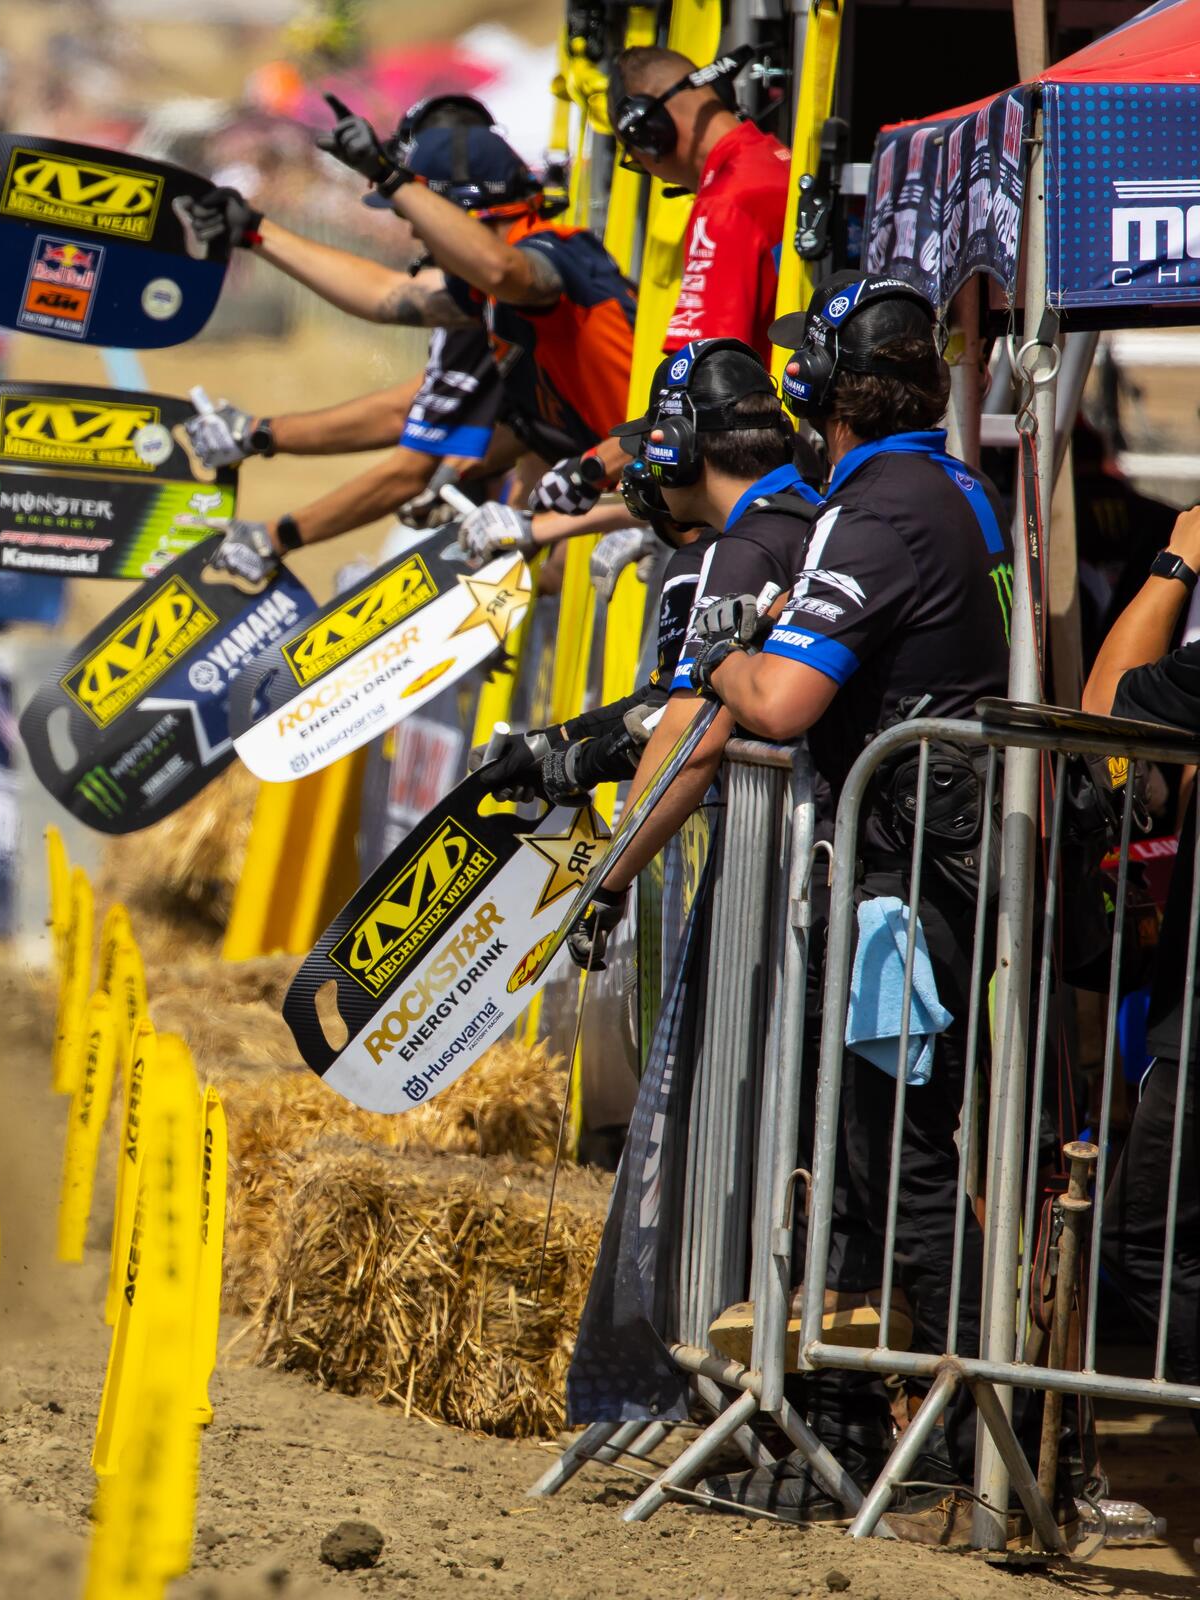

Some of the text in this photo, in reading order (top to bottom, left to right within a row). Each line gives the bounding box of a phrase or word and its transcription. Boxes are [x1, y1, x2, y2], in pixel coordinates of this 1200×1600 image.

[97, 213, 147, 234] WEAR
[34, 291, 81, 313] KTM
[0, 489, 115, 521] MONSTER
[14, 514, 97, 530] ENERGY
[1, 547, 99, 573] Kawasaki
[208, 589, 298, 670] YAMAHA
[768, 628, 816, 649] THOR
[277, 626, 421, 738] ROCKSTAR
[299, 690, 361, 740] ENERGY
[362, 655, 416, 696] DRINK
[308, 703, 387, 761] Husqvarna
[364, 851, 491, 990] MECHANIX WEAR
[363, 899, 506, 1066] ROCKSTAR
[397, 935, 509, 1063] ENERGY DRINK
[422, 999, 499, 1083] Husqvarna
